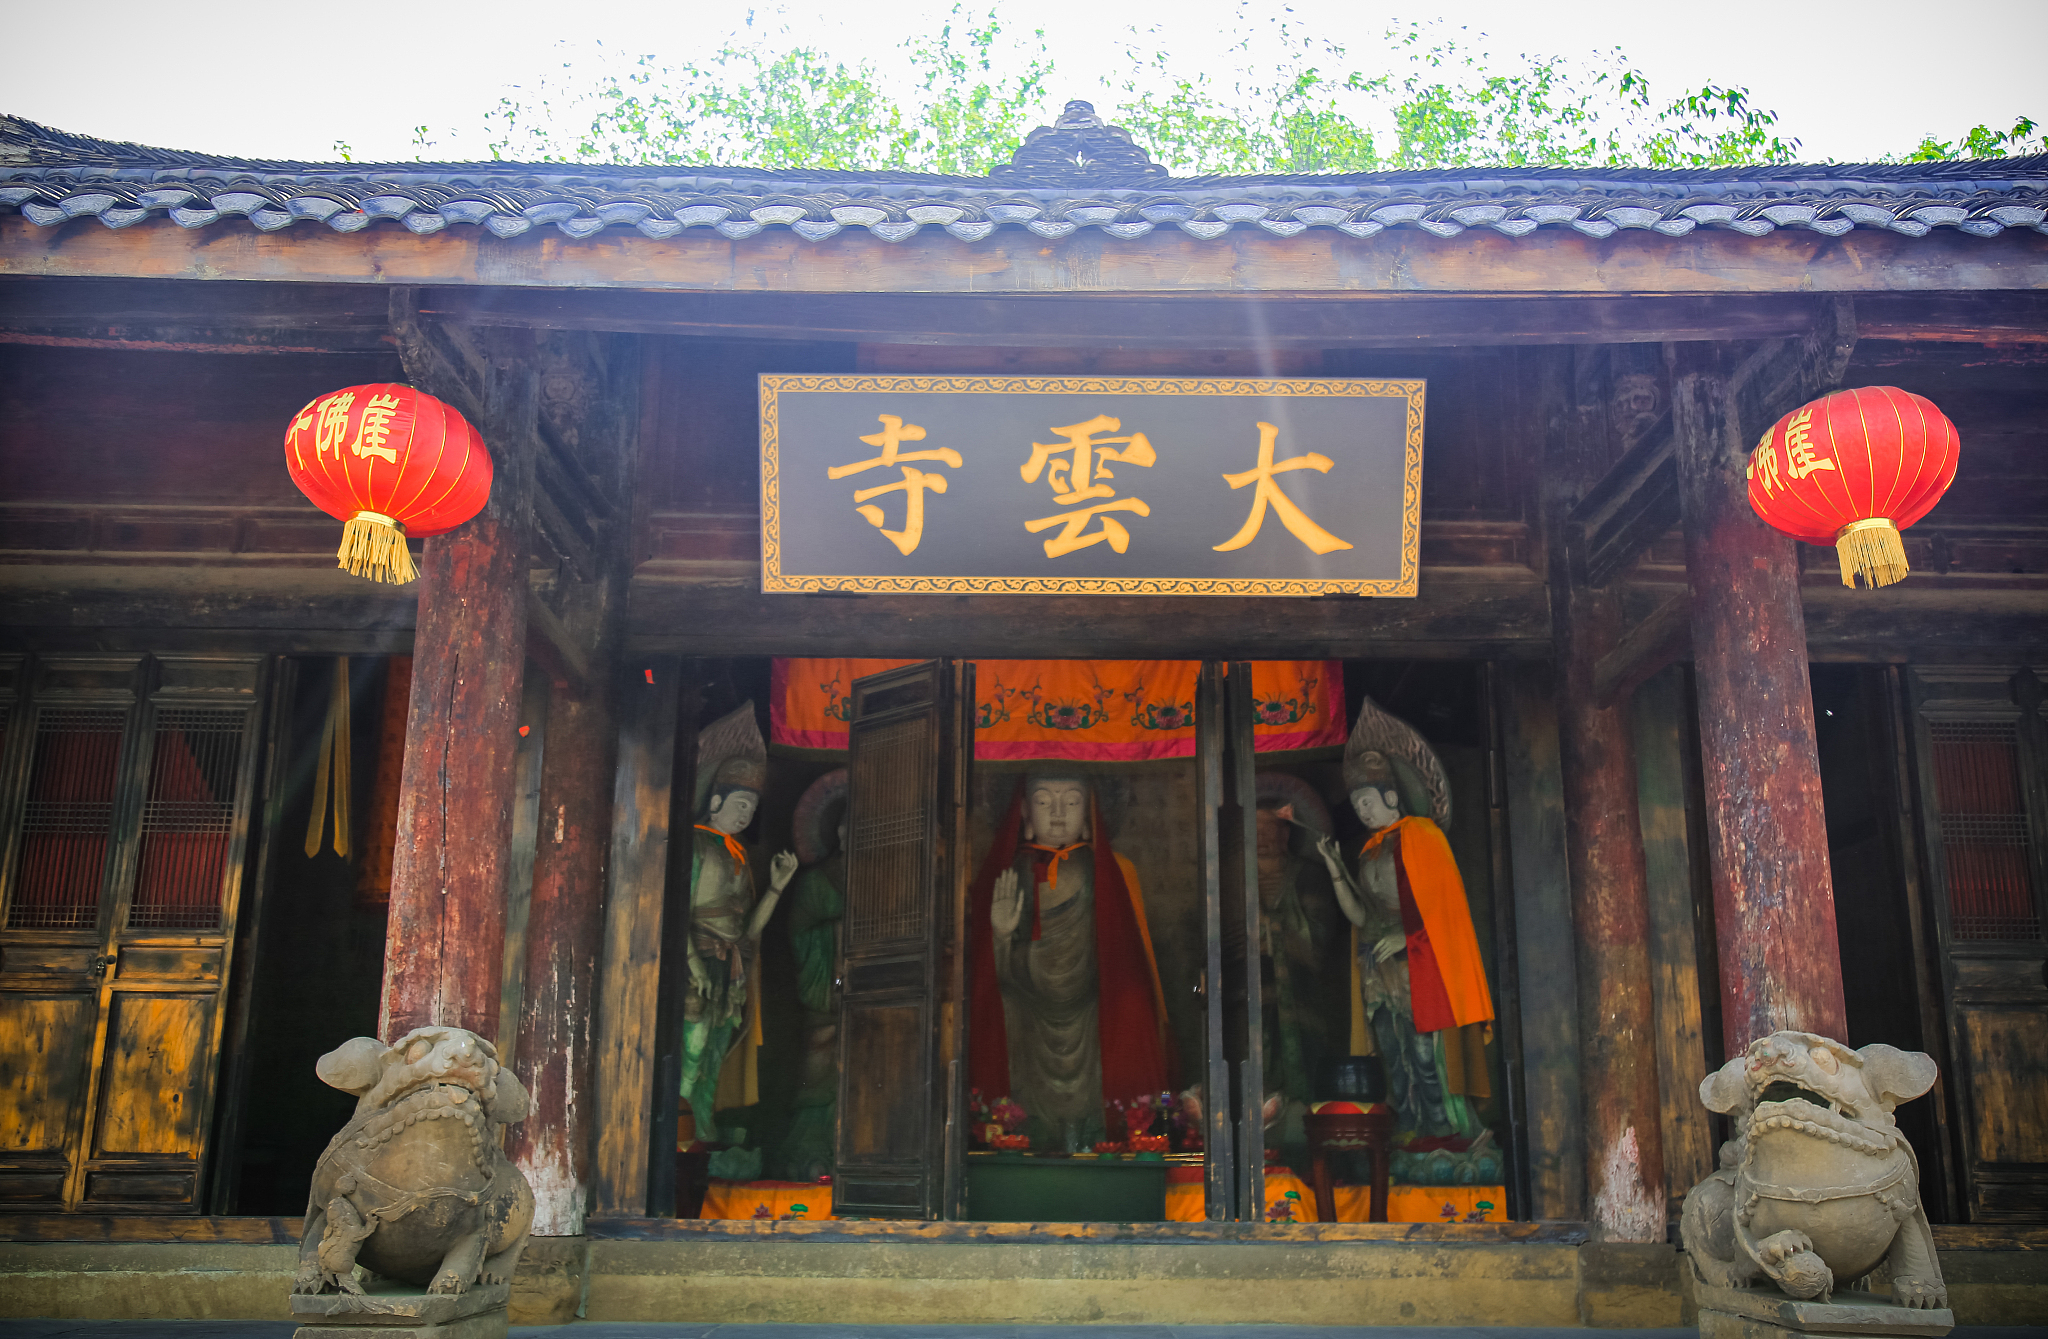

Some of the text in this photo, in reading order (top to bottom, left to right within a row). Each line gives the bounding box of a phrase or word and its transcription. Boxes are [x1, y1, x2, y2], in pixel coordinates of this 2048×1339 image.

[827, 413, 1355, 559] 大雲寺
[1746, 408, 1837, 501] 佛崖
